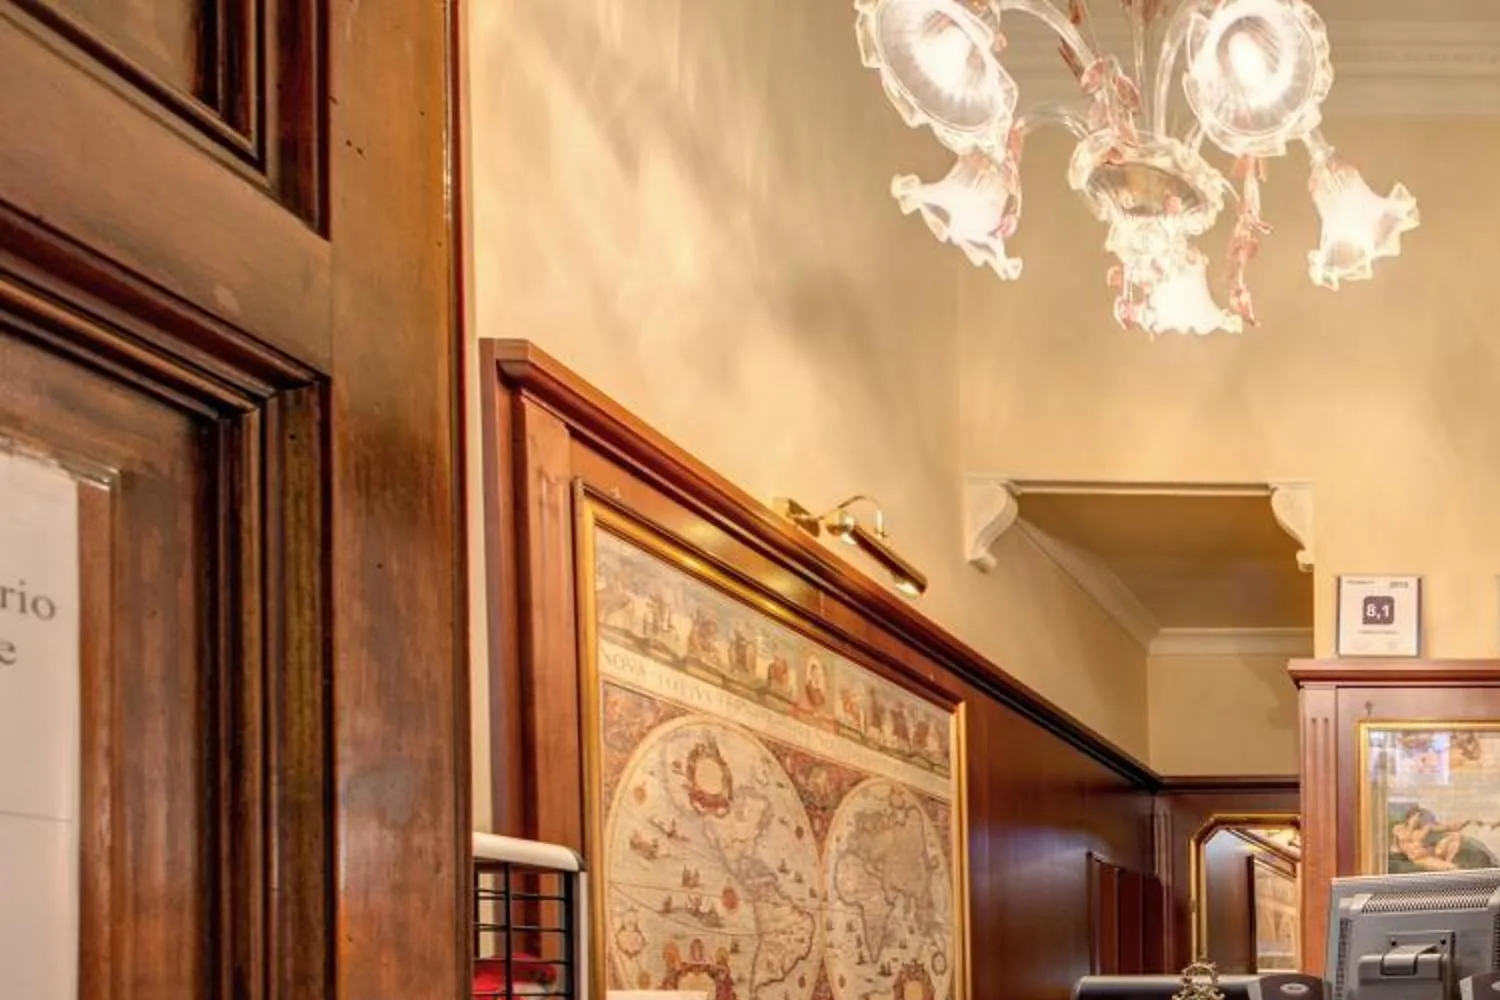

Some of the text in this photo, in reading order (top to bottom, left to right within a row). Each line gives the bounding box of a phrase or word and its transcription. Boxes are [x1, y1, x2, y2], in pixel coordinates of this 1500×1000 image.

[0, 579, 57, 621] rio
[1367, 603, 1390, 620] 8,1
[0, 640, 17, 666] e
